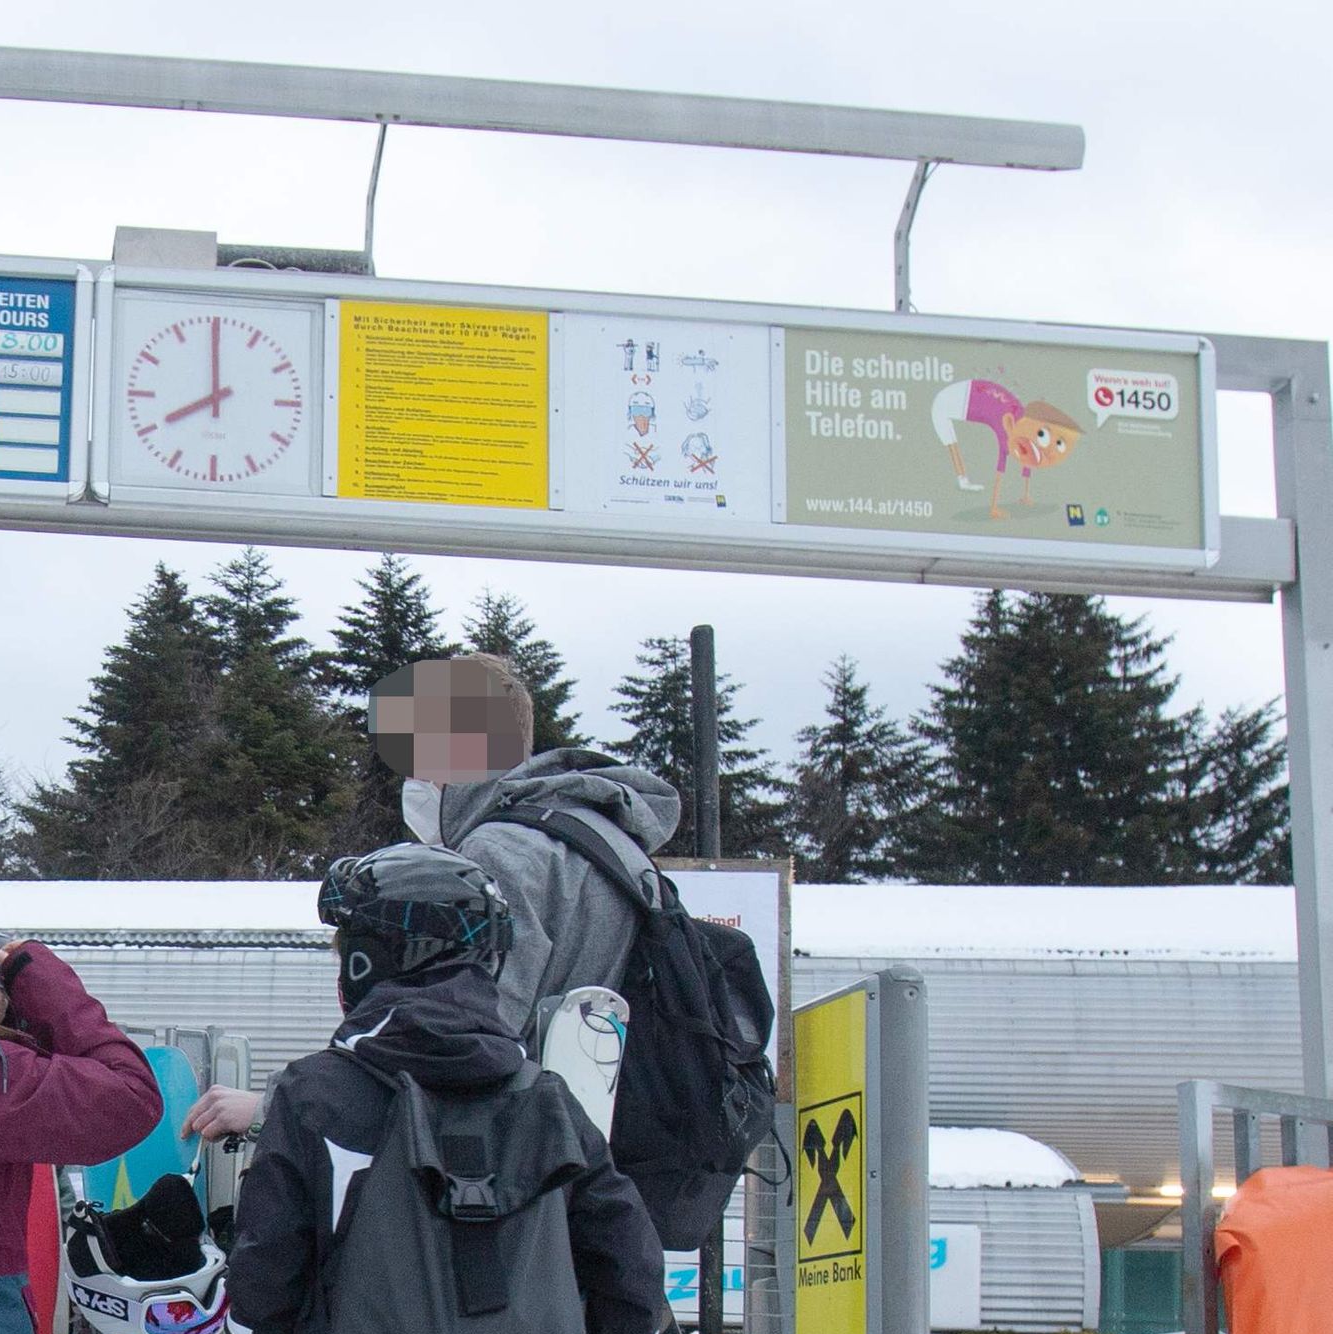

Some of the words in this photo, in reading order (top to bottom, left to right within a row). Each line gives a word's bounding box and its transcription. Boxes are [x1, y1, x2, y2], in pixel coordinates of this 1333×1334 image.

[354, 315, 370, 324] Mit
[374, 317, 426, 326] Sicherheit
[430, 321, 456, 329] mehr
[805, 349, 844, 377] Die
[852, 354, 954, 382] schnelle
[805, 380, 861, 408] Hilfe
[871, 388, 907, 410] am
[1116, 389, 1171, 411] 1450
[805, 411, 902, 440] Telefon.
[619, 475, 670, 488] Schützen
[673, 479, 692, 489] wir
[695, 480, 718, 490] uns!
[805, 498, 933, 517] www.144.at/1450
[798, 1265, 830, 1288] Meine
[832, 1258, 862, 1283] Bank
